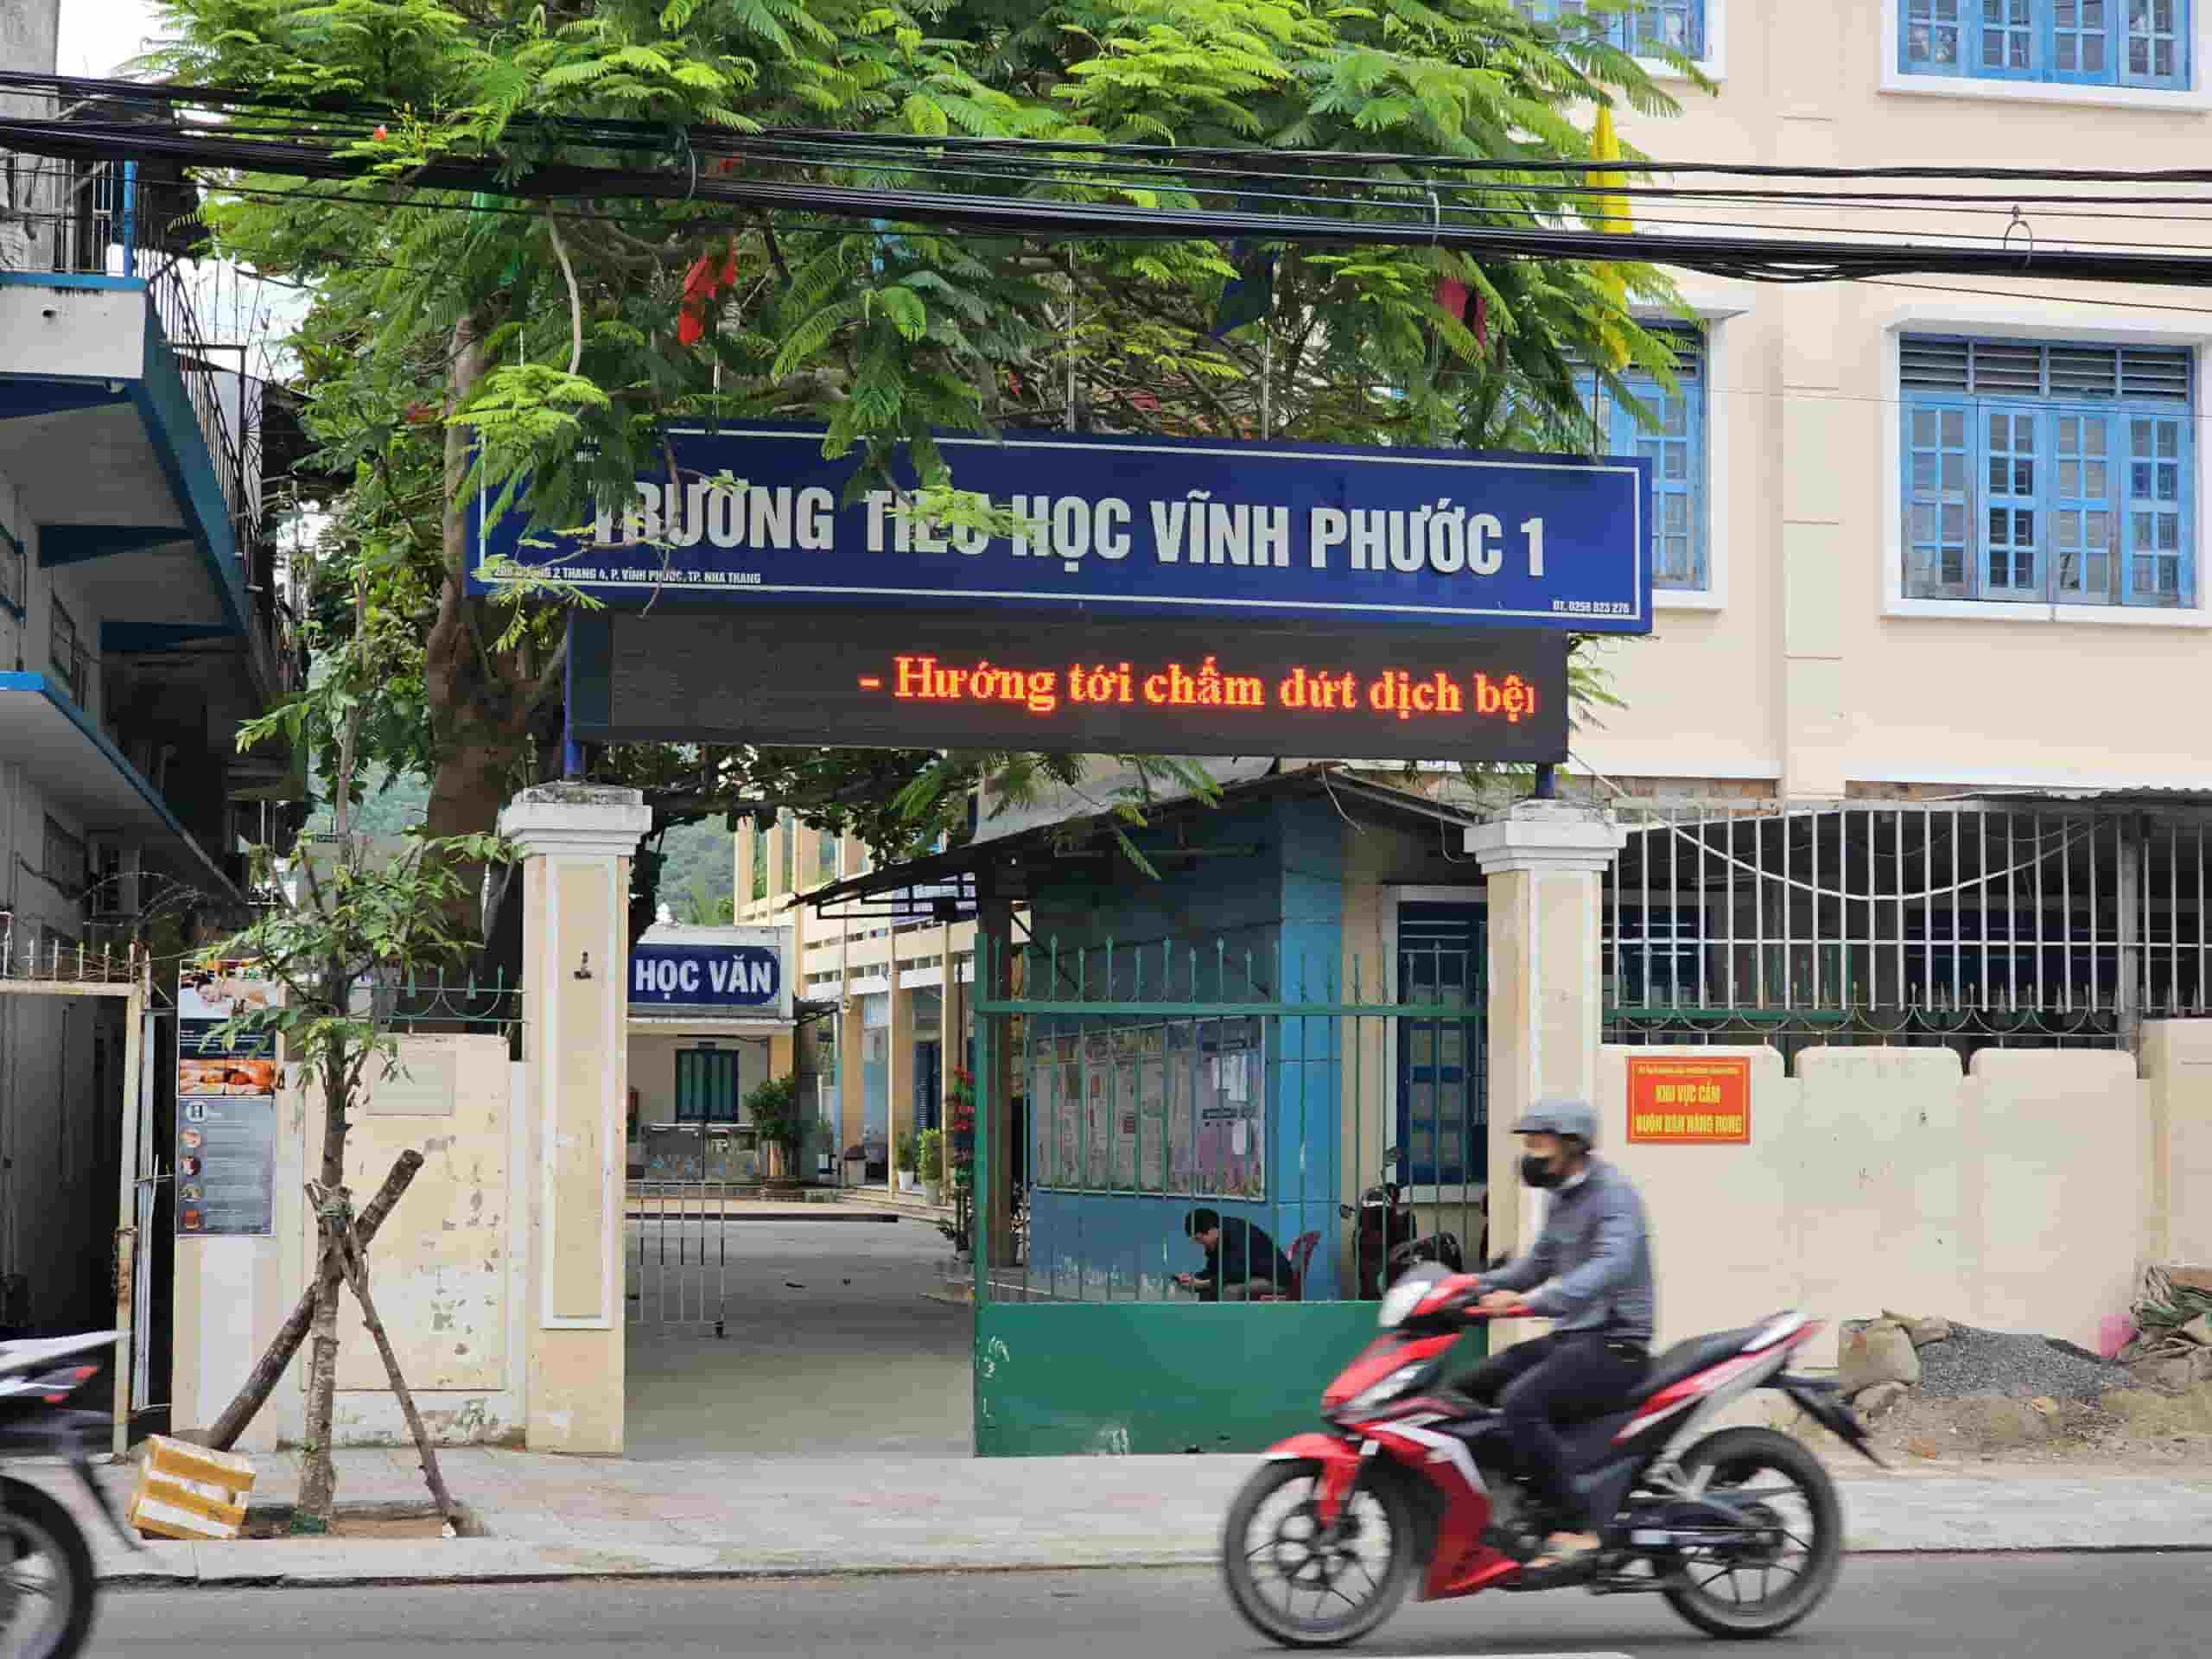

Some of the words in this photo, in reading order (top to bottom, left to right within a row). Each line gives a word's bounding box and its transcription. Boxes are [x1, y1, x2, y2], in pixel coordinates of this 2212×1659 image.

[1013, 494, 1131, 572] HỌC
[1149, 490, 1290, 567] VĨNH
[1311, 498, 1503, 575] PHƯỚC
[1521, 517, 1544, 576] 1
[704, 570, 726, 582] NHA
[893, 657, 1057, 712] Hướng
[1069, 662, 1135, 703] tới
[1143, 655, 1265, 707] chấm
[1279, 667, 1358, 709] dứt
[1369, 671, 1463, 721] dịch
[635, 959, 699, 1001] HỌC
[709, 953, 772, 994] VĂN
[1656, 1084, 1675, 1103] KHU
